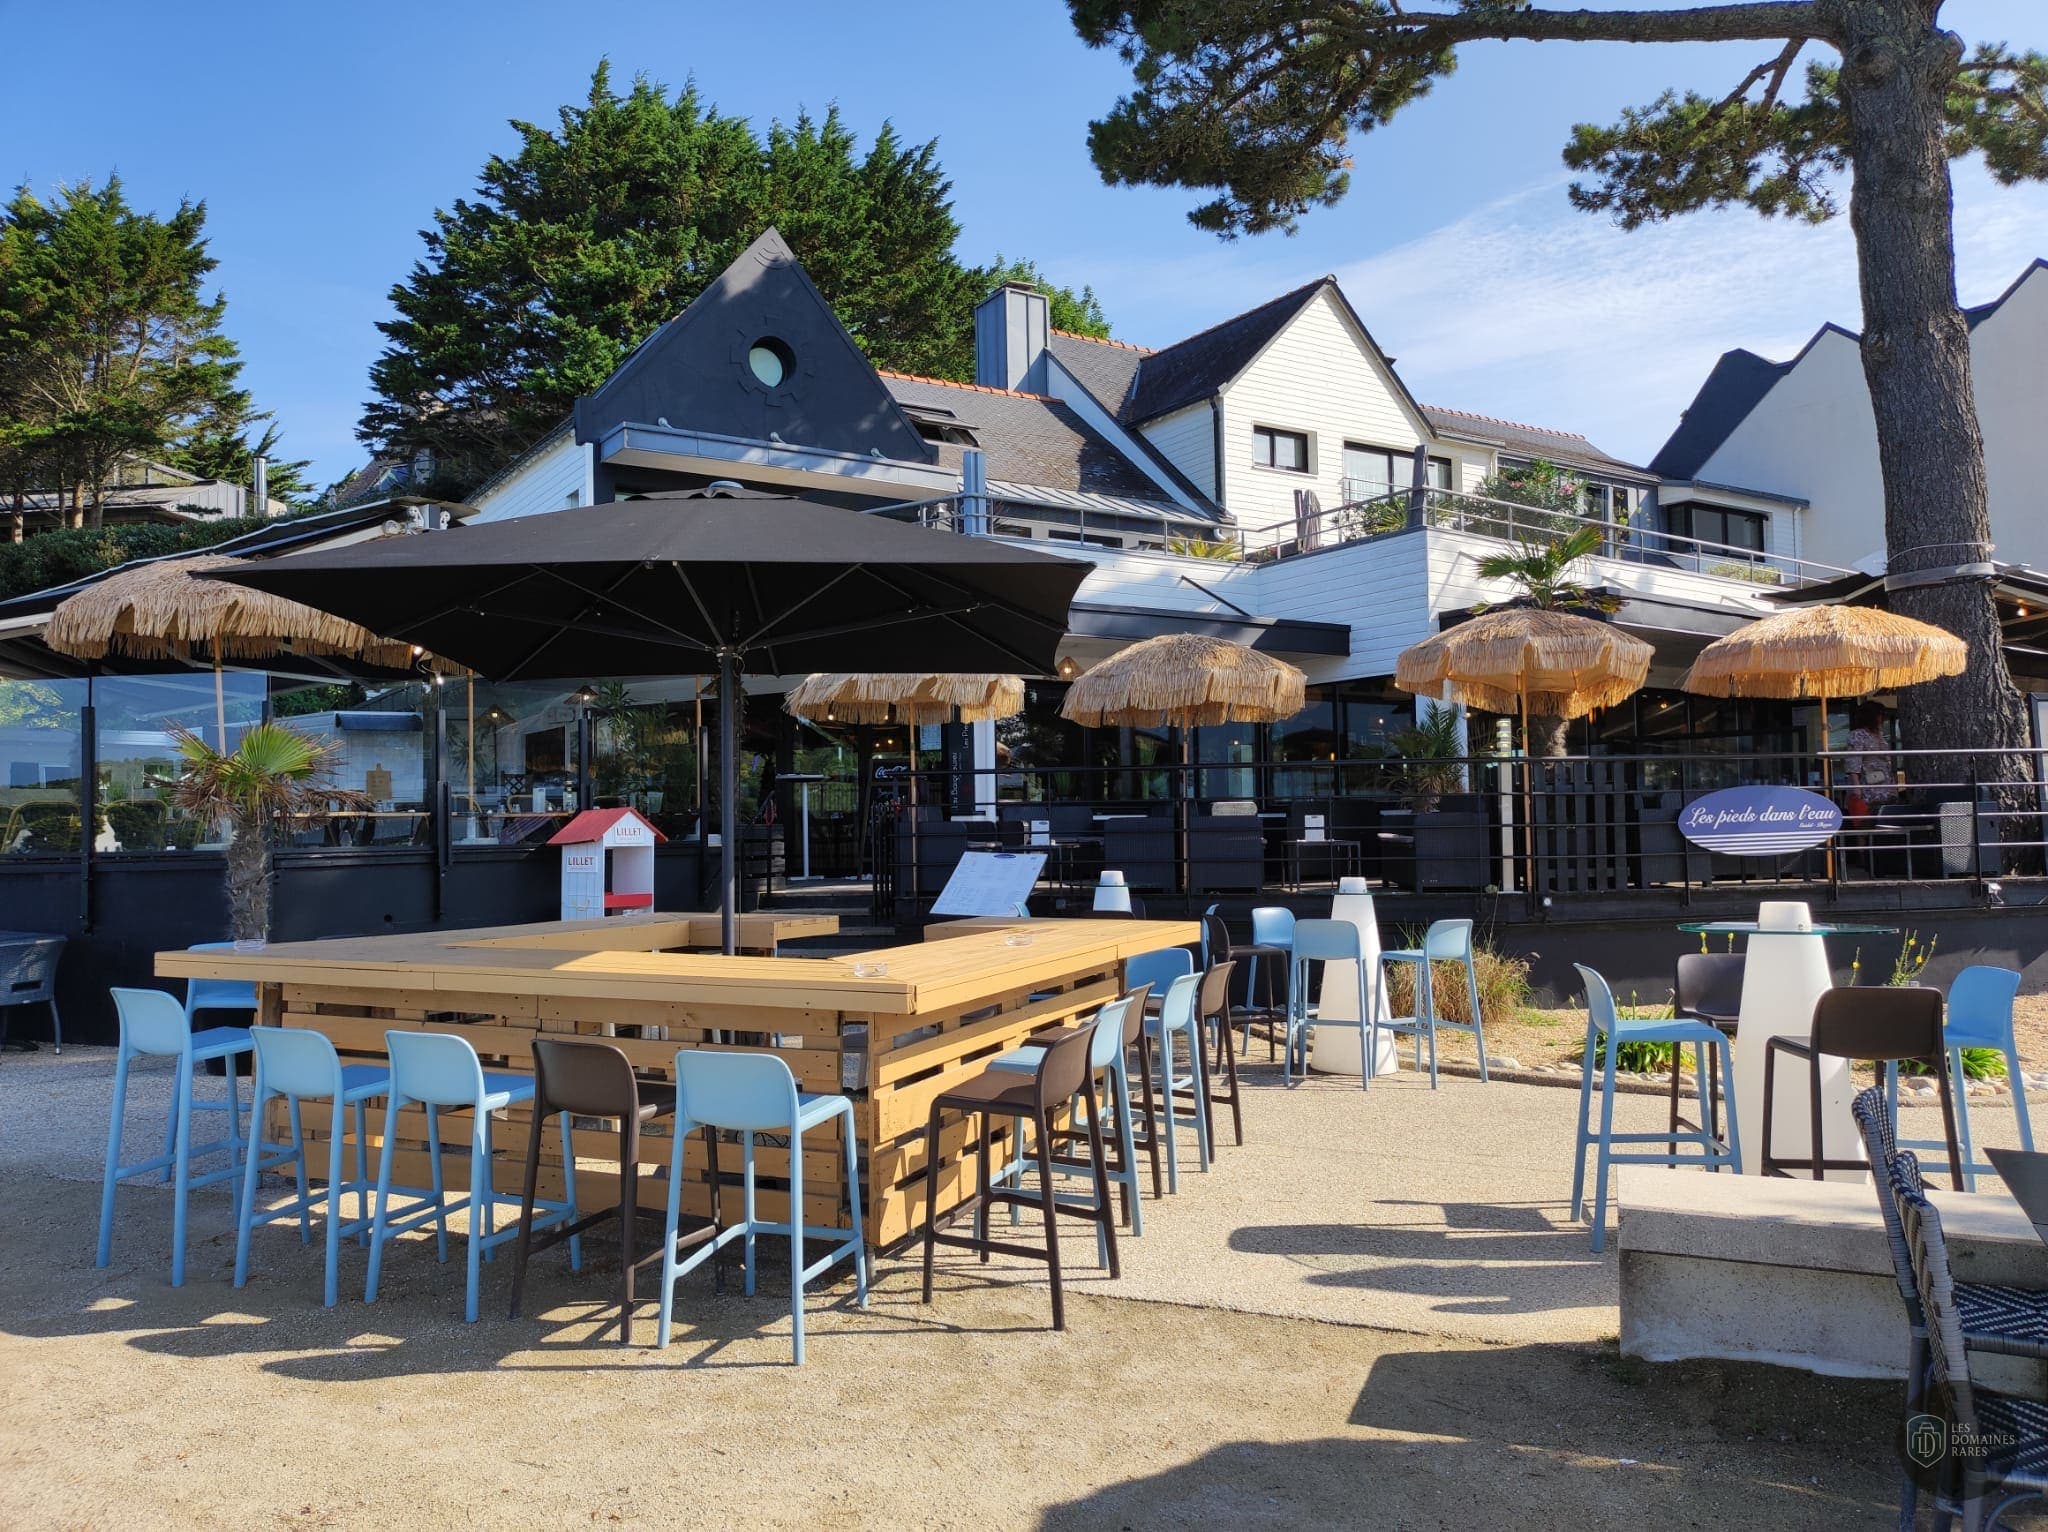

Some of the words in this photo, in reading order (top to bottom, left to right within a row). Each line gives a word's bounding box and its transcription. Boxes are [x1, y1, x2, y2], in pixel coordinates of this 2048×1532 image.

[1686, 807, 1714, 828] Les
[1713, 806, 1757, 830] pieds
[1759, 805, 1796, 822] dans
[1798, 804, 1836, 820] l'eau
[616, 827, 641, 836] LILLET
[568, 857, 593, 866] LILLET
